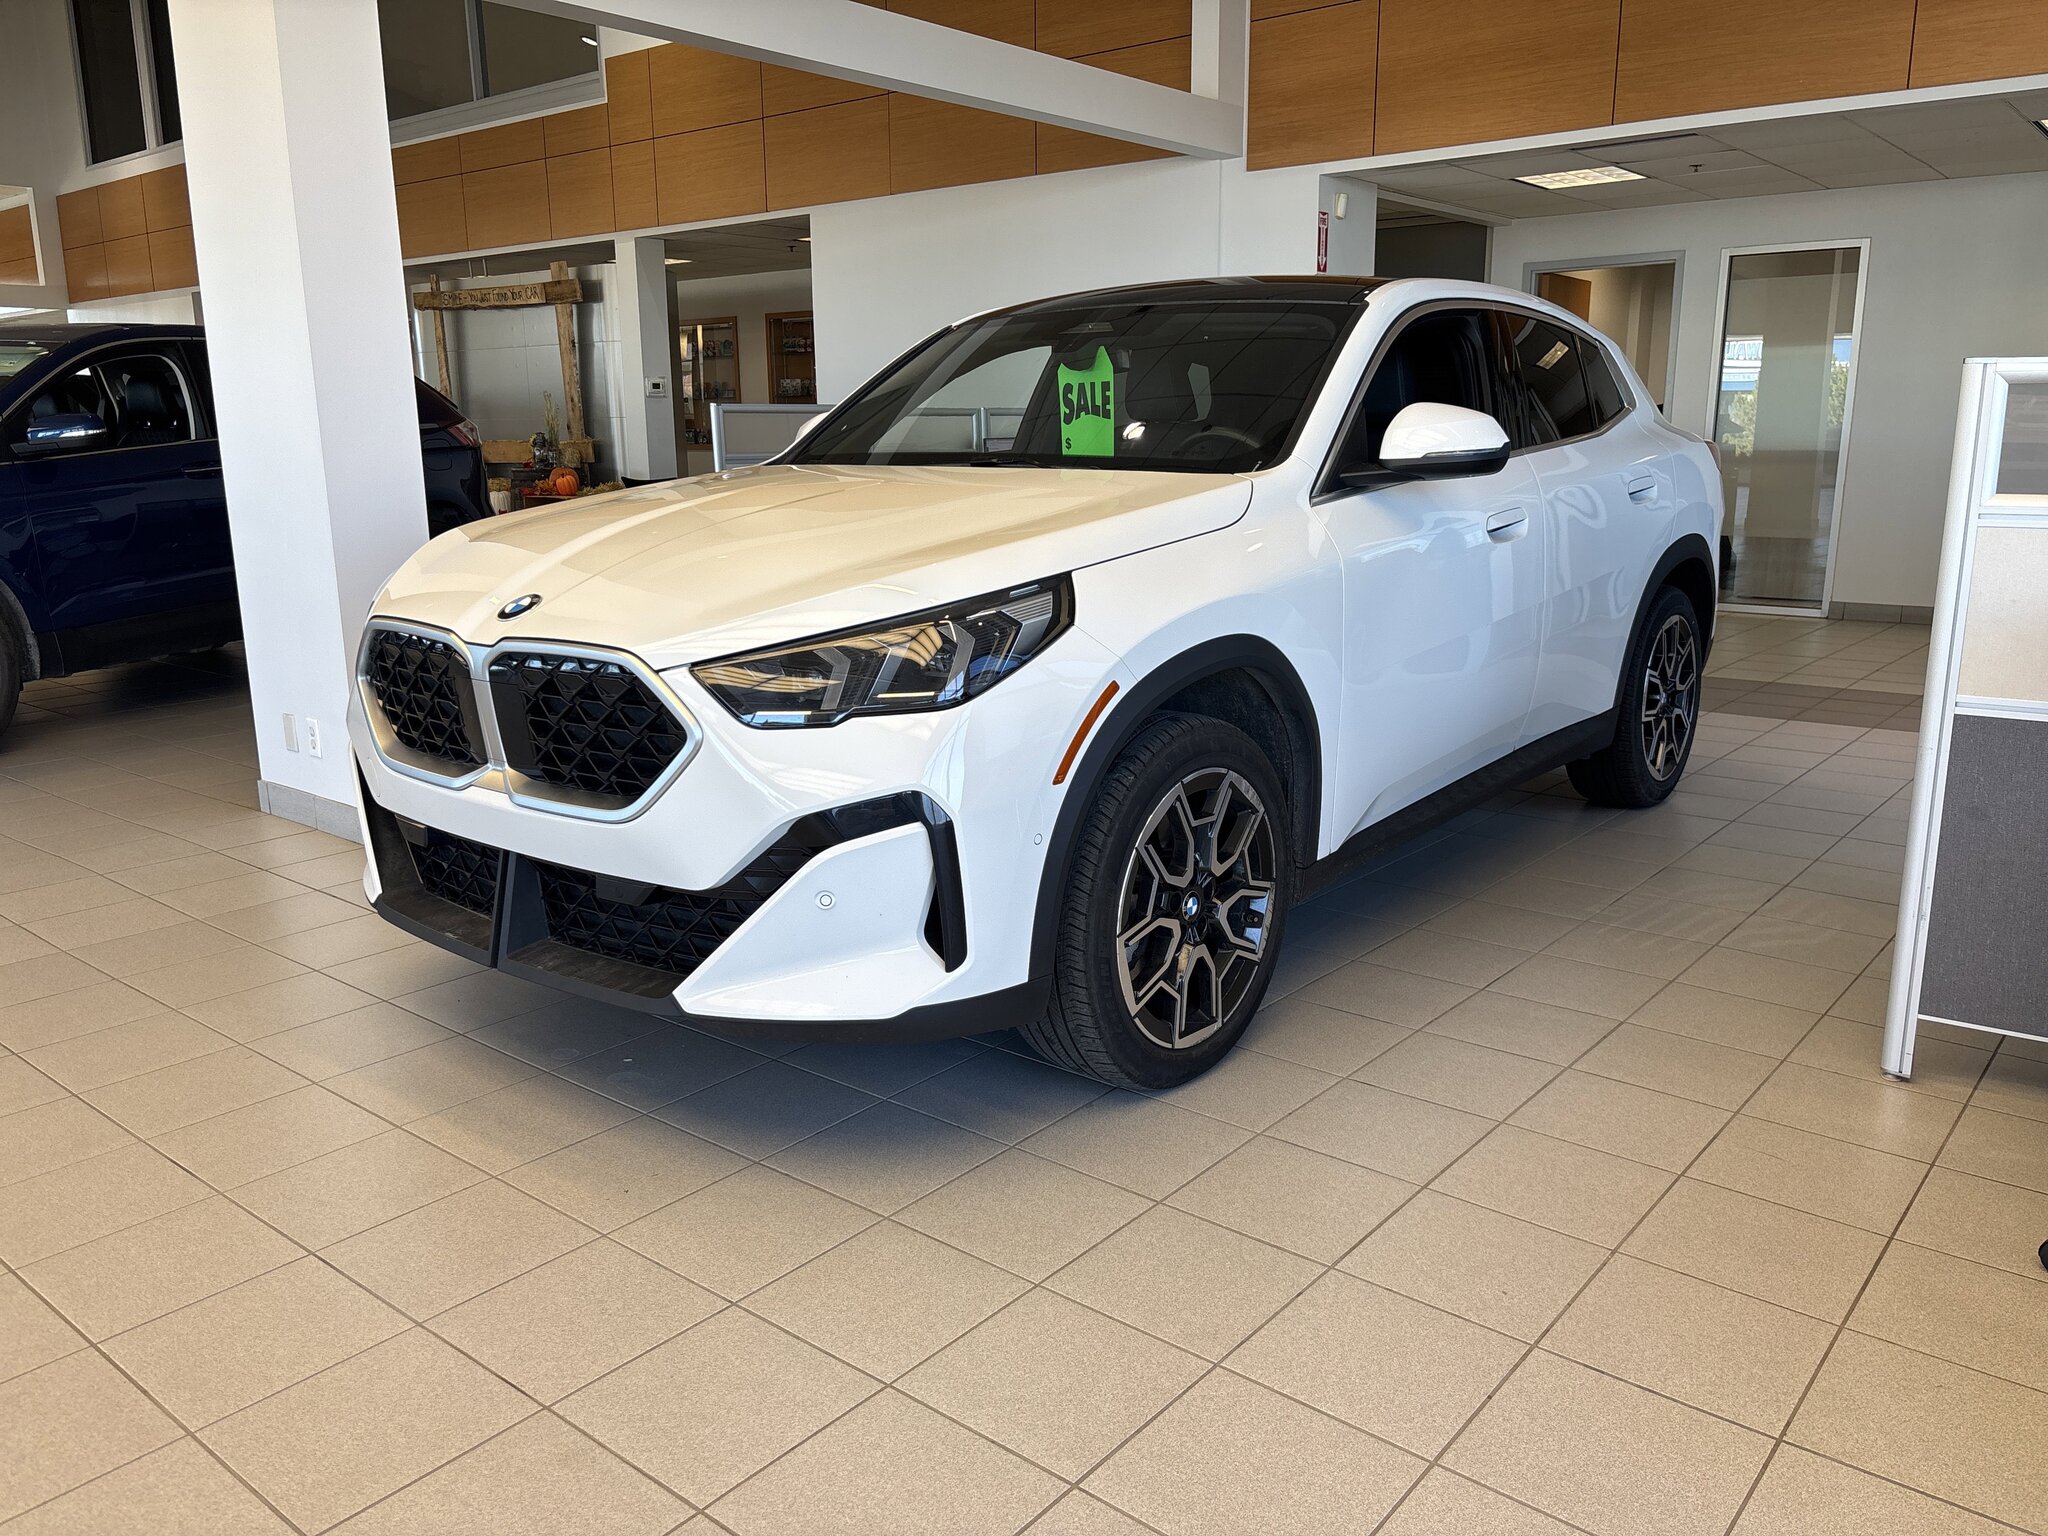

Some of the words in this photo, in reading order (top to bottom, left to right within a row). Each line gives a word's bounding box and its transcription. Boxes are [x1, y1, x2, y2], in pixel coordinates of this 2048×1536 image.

[443, 293, 464, 306] SMILE
[525, 286, 540, 300] CAR
[1063, 381, 1111, 425] SALE
[1065, 437, 1072, 450] $
